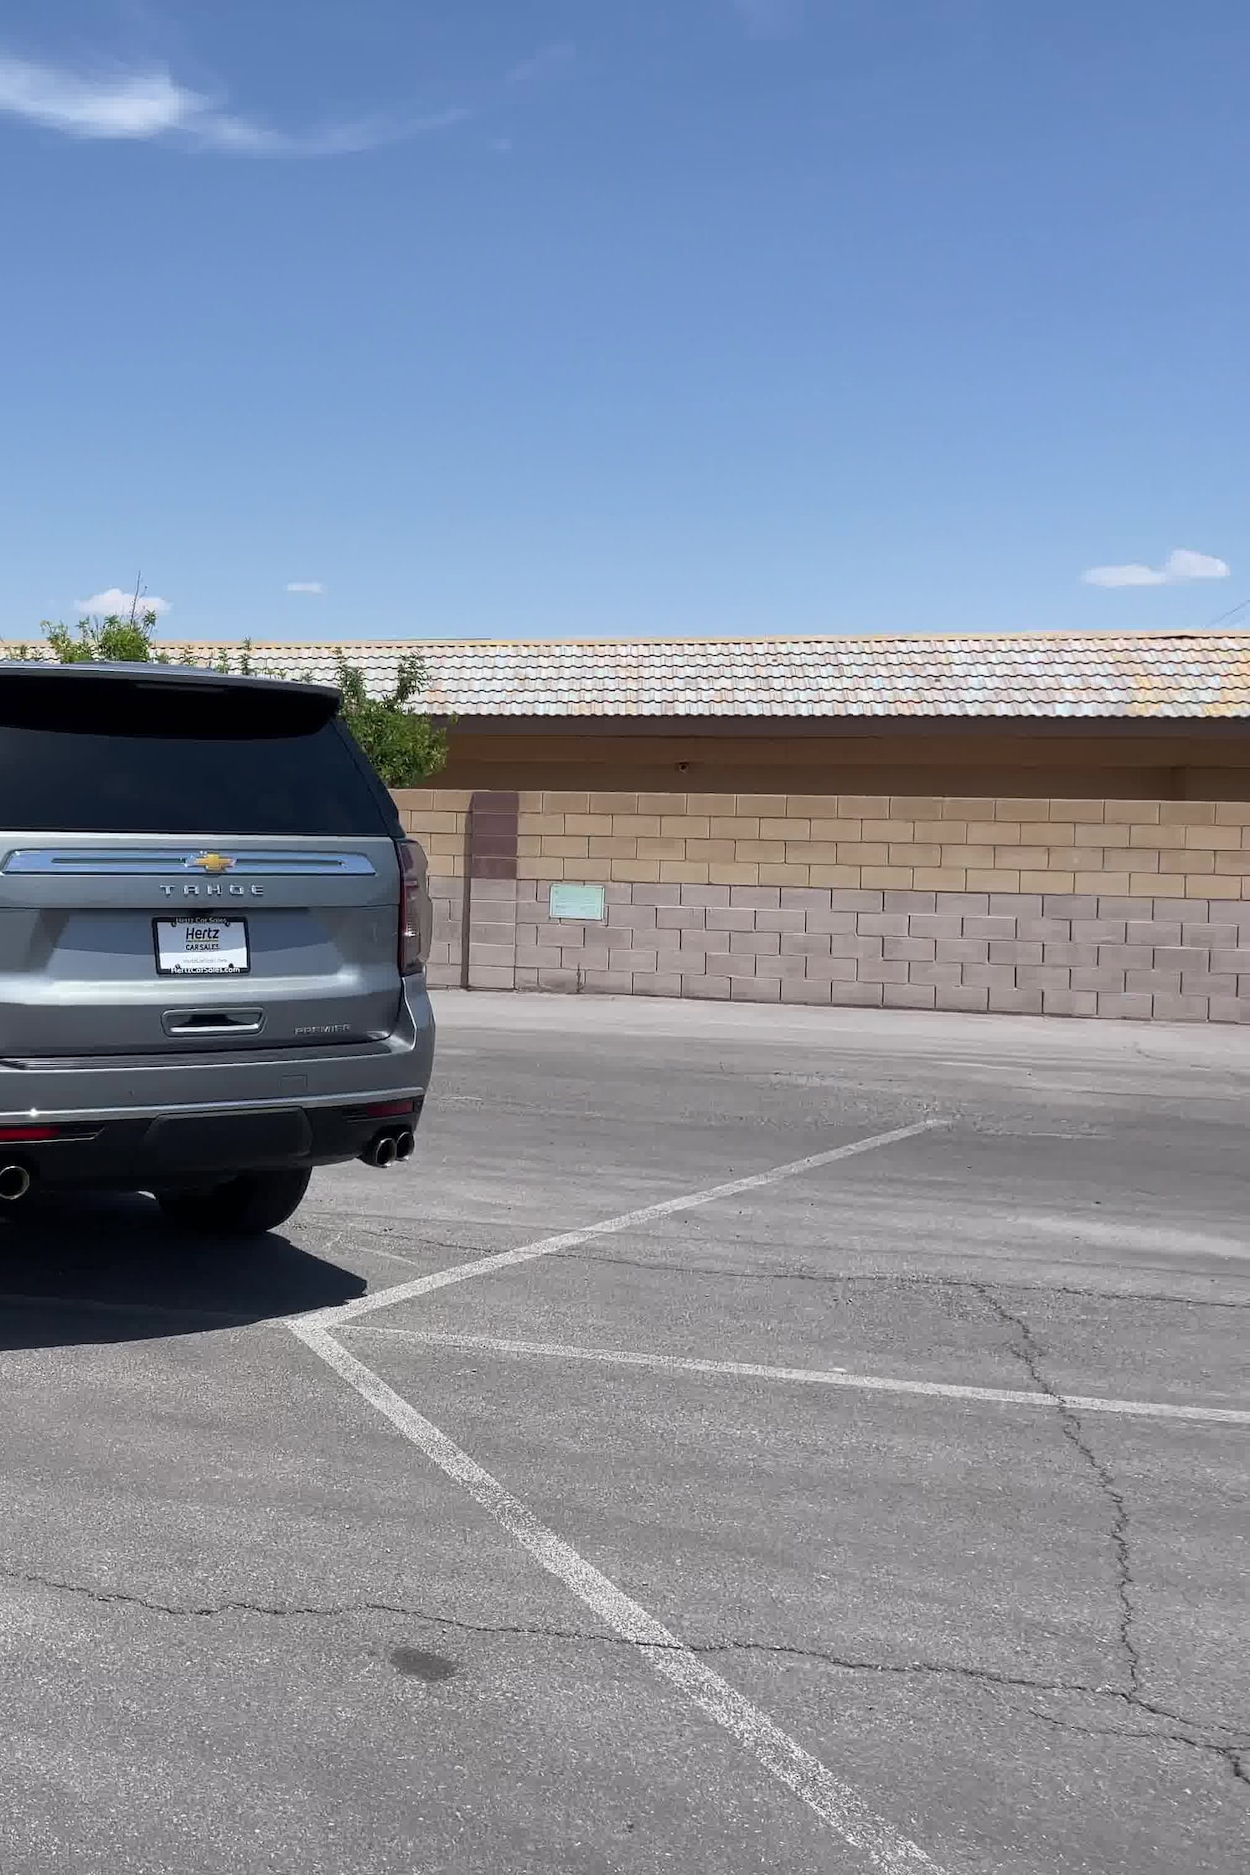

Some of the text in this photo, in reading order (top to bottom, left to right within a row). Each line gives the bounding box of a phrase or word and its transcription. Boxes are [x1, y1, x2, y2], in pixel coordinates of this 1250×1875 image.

[160, 885, 264, 896] TAHOE
[186, 928, 219, 940] Hertz
[171, 967, 241, 975] HertzCarSales.com
